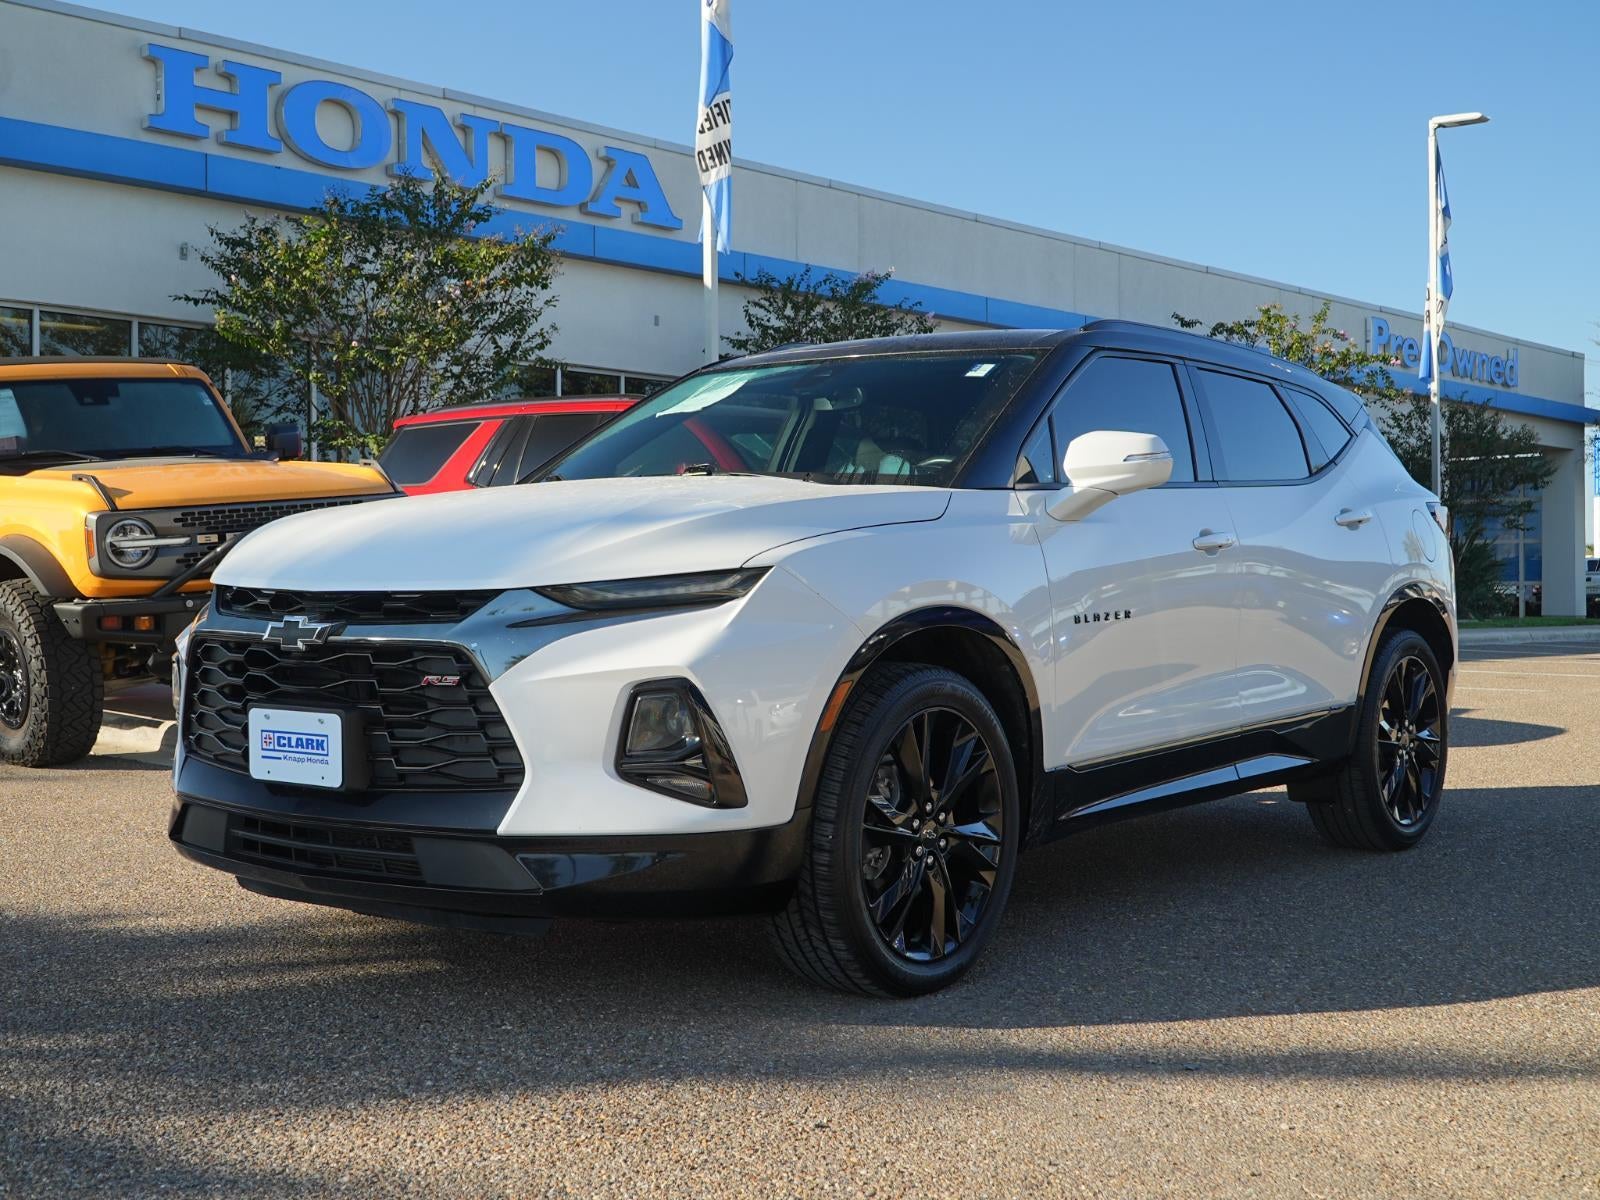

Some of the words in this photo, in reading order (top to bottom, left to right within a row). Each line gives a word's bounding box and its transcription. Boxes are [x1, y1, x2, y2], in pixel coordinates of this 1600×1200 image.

[142, 43, 683, 230] HONDA
[1073, 609, 1132, 625] BLAZER
[420, 675, 461, 686] RS
[276, 735, 326, 752] CLARK
[282, 754, 306, 764] Knapp
[306, 756, 329, 766] Honda
